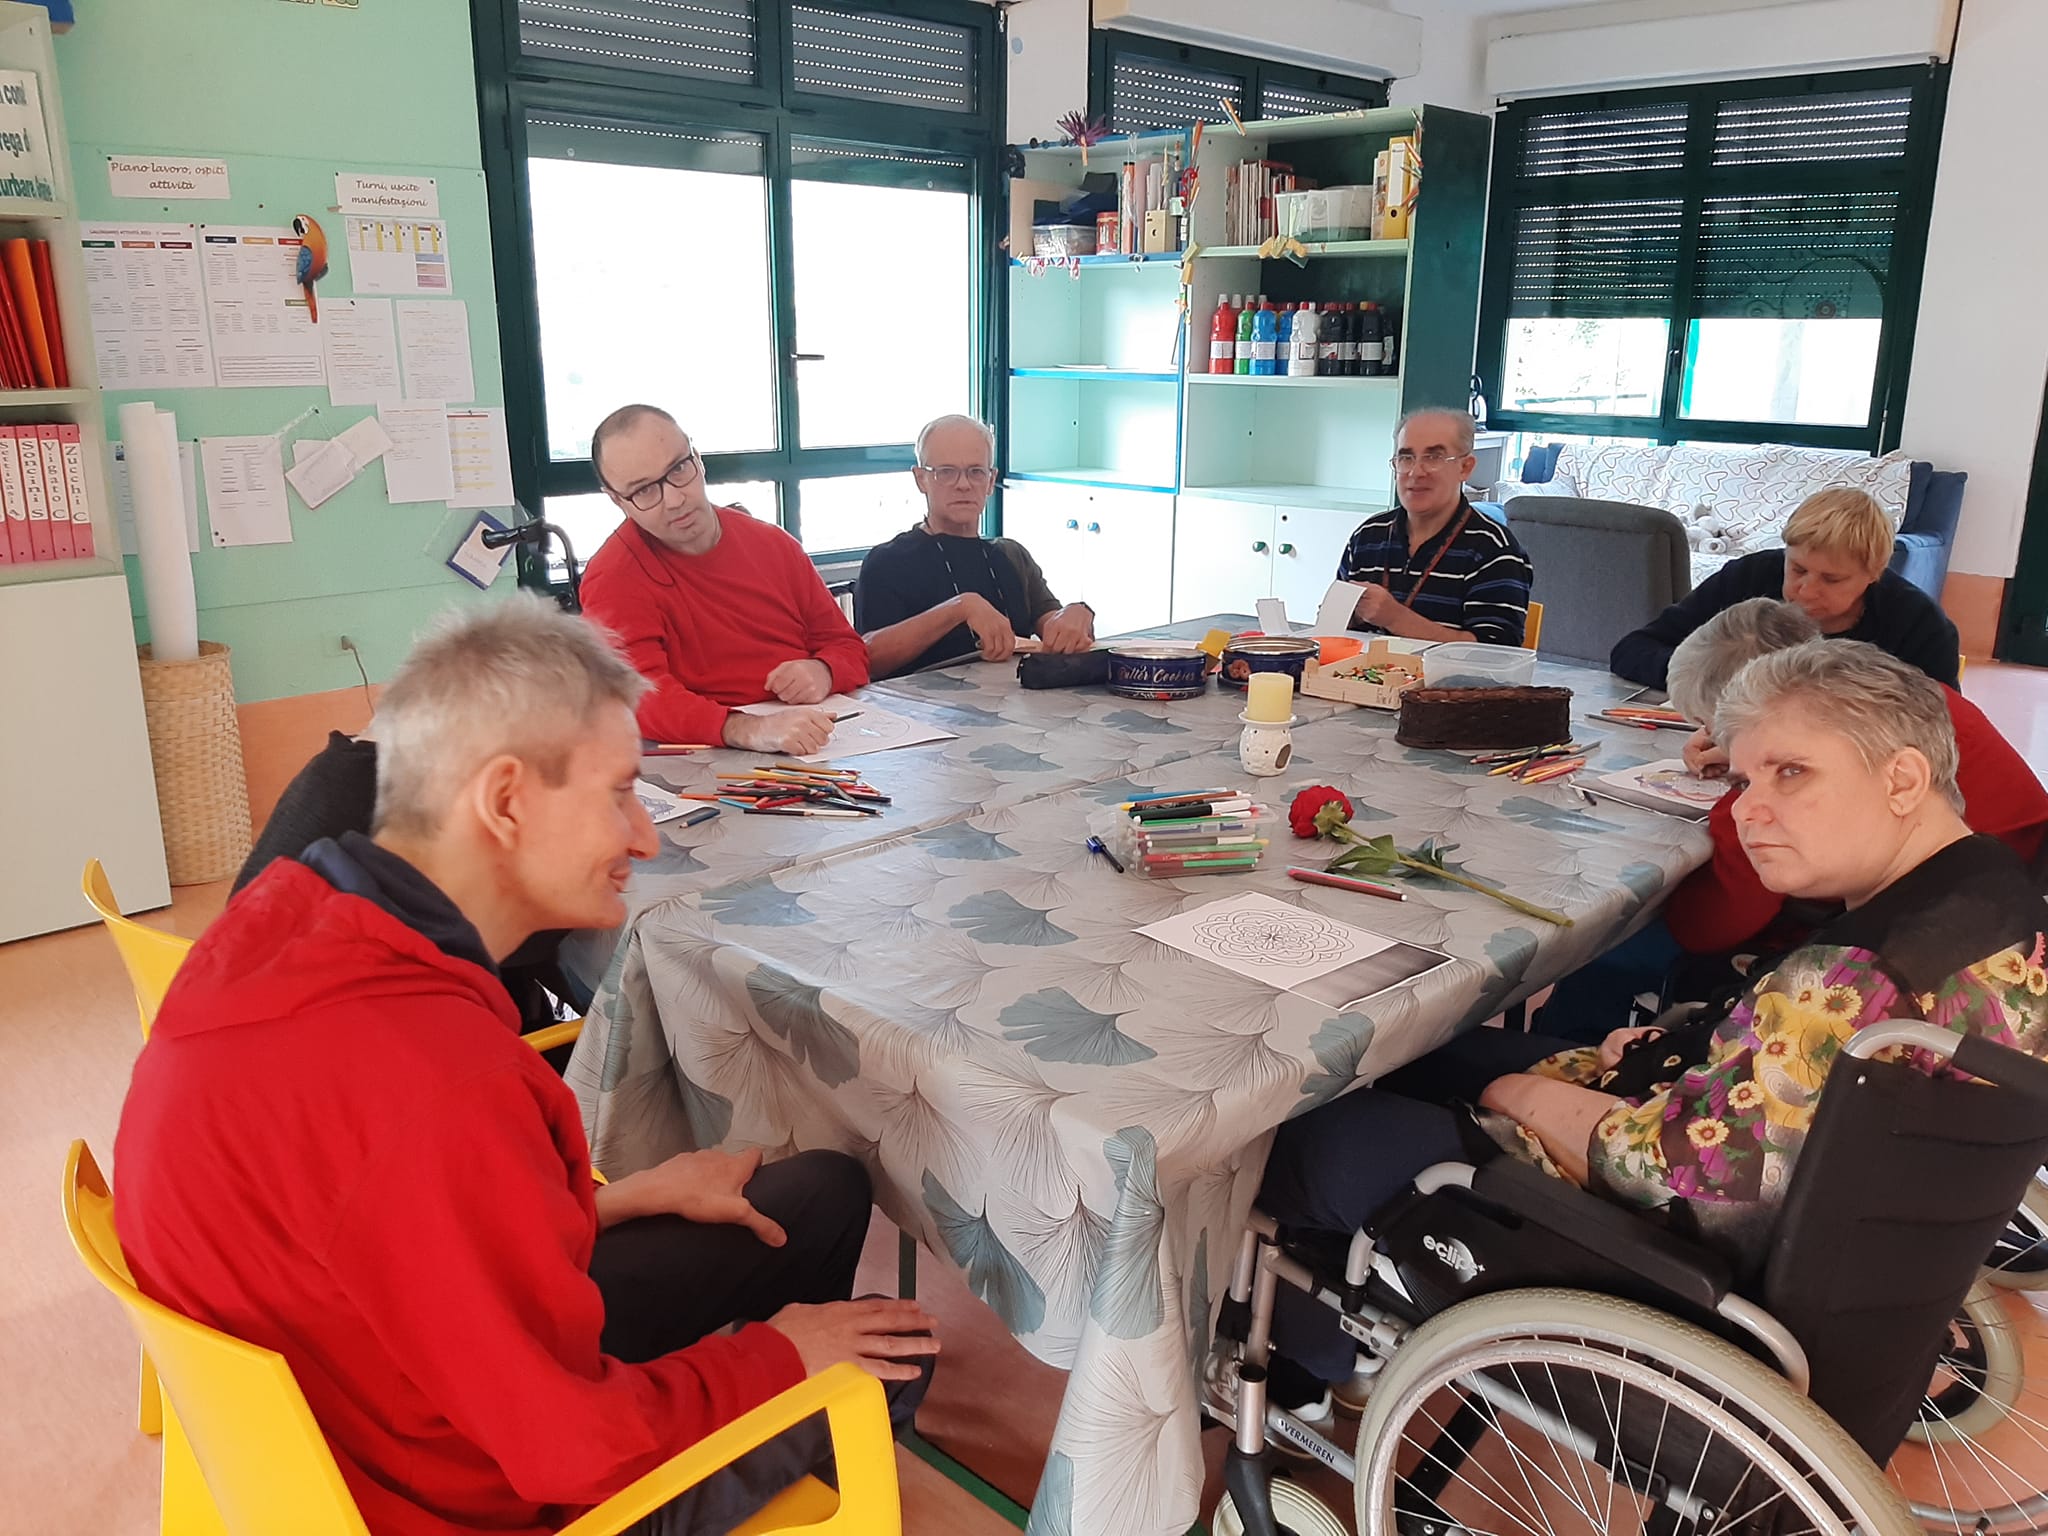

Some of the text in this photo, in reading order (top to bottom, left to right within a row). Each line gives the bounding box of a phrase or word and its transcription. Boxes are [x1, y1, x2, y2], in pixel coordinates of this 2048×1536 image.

[111, 162, 225, 176] Piano lavoro, ospiti
[149, 180, 195, 190] attività
[356, 180, 420, 192] Turni, uscite
[351, 195, 428, 208] manifestazioni
[21, 440, 44, 519] Soncini S
[42, 441, 66, 519] Vigato C
[65, 446, 87, 522] Zucchi C
[1283, 1421, 1335, 1464] VERMEIREN
